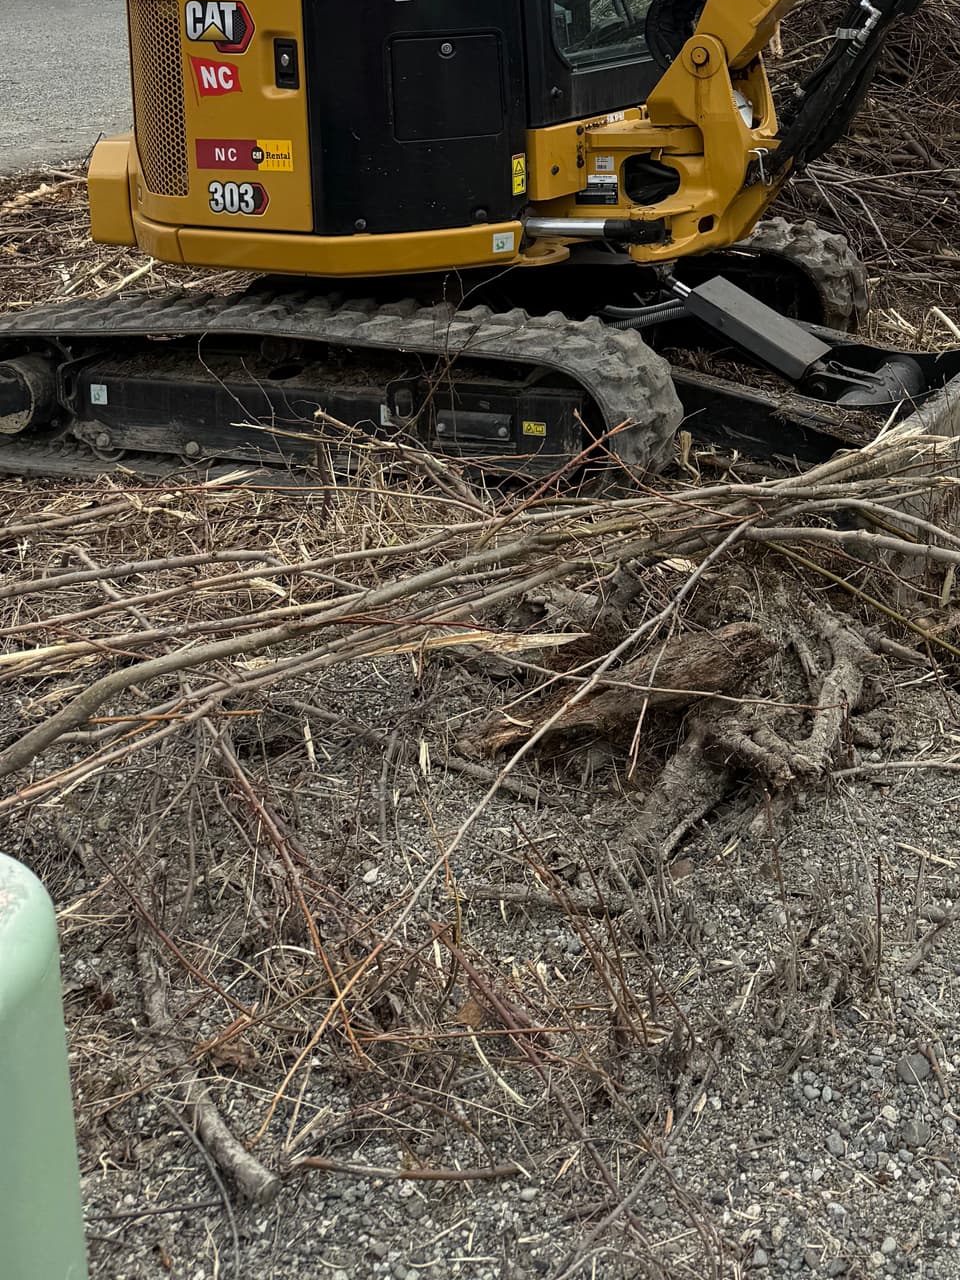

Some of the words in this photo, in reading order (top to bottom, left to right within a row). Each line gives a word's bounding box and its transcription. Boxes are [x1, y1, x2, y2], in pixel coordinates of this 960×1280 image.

[185, 0, 237, 41] CAT
[200, 66, 234, 89] NC
[215, 148, 238, 162] NC
[266, 151, 291, 160] Rental
[208, 181, 256, 214] 303
